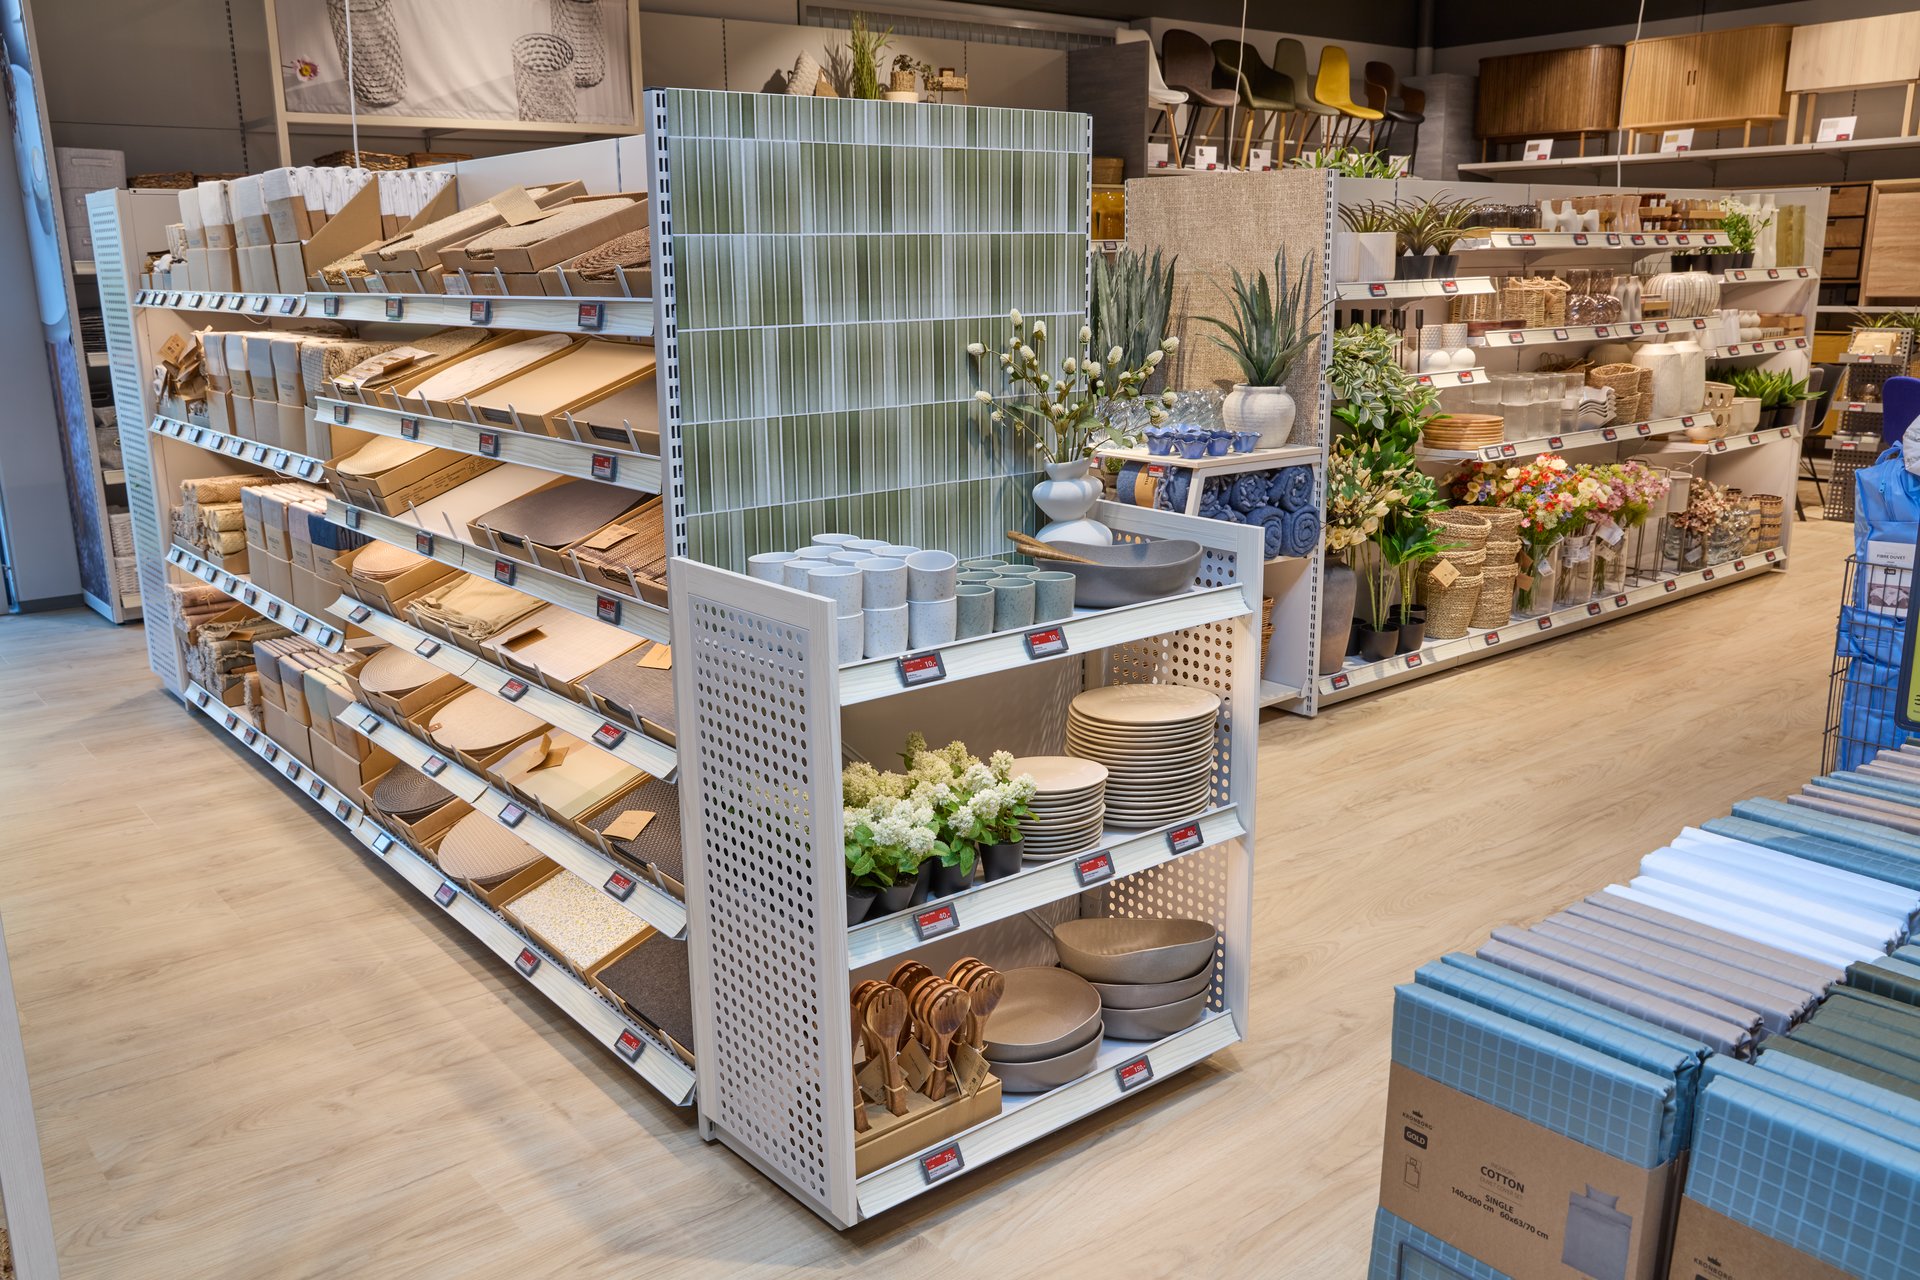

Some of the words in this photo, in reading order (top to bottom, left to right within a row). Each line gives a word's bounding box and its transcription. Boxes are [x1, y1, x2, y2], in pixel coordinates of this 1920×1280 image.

[1402, 1111, 1433, 1131] KRONBORG
[1406, 1131, 1426, 1145] GOLD
[1480, 1165, 1525, 1193] COTTON
[1451, 1186, 1483, 1207] 140x200
[1483, 1201, 1495, 1214] cm
[1499, 1211, 1536, 1234] 60x63/70
[1536, 1228, 1549, 1240] cm
[1485, 1194, 1514, 1214] SINGLE
